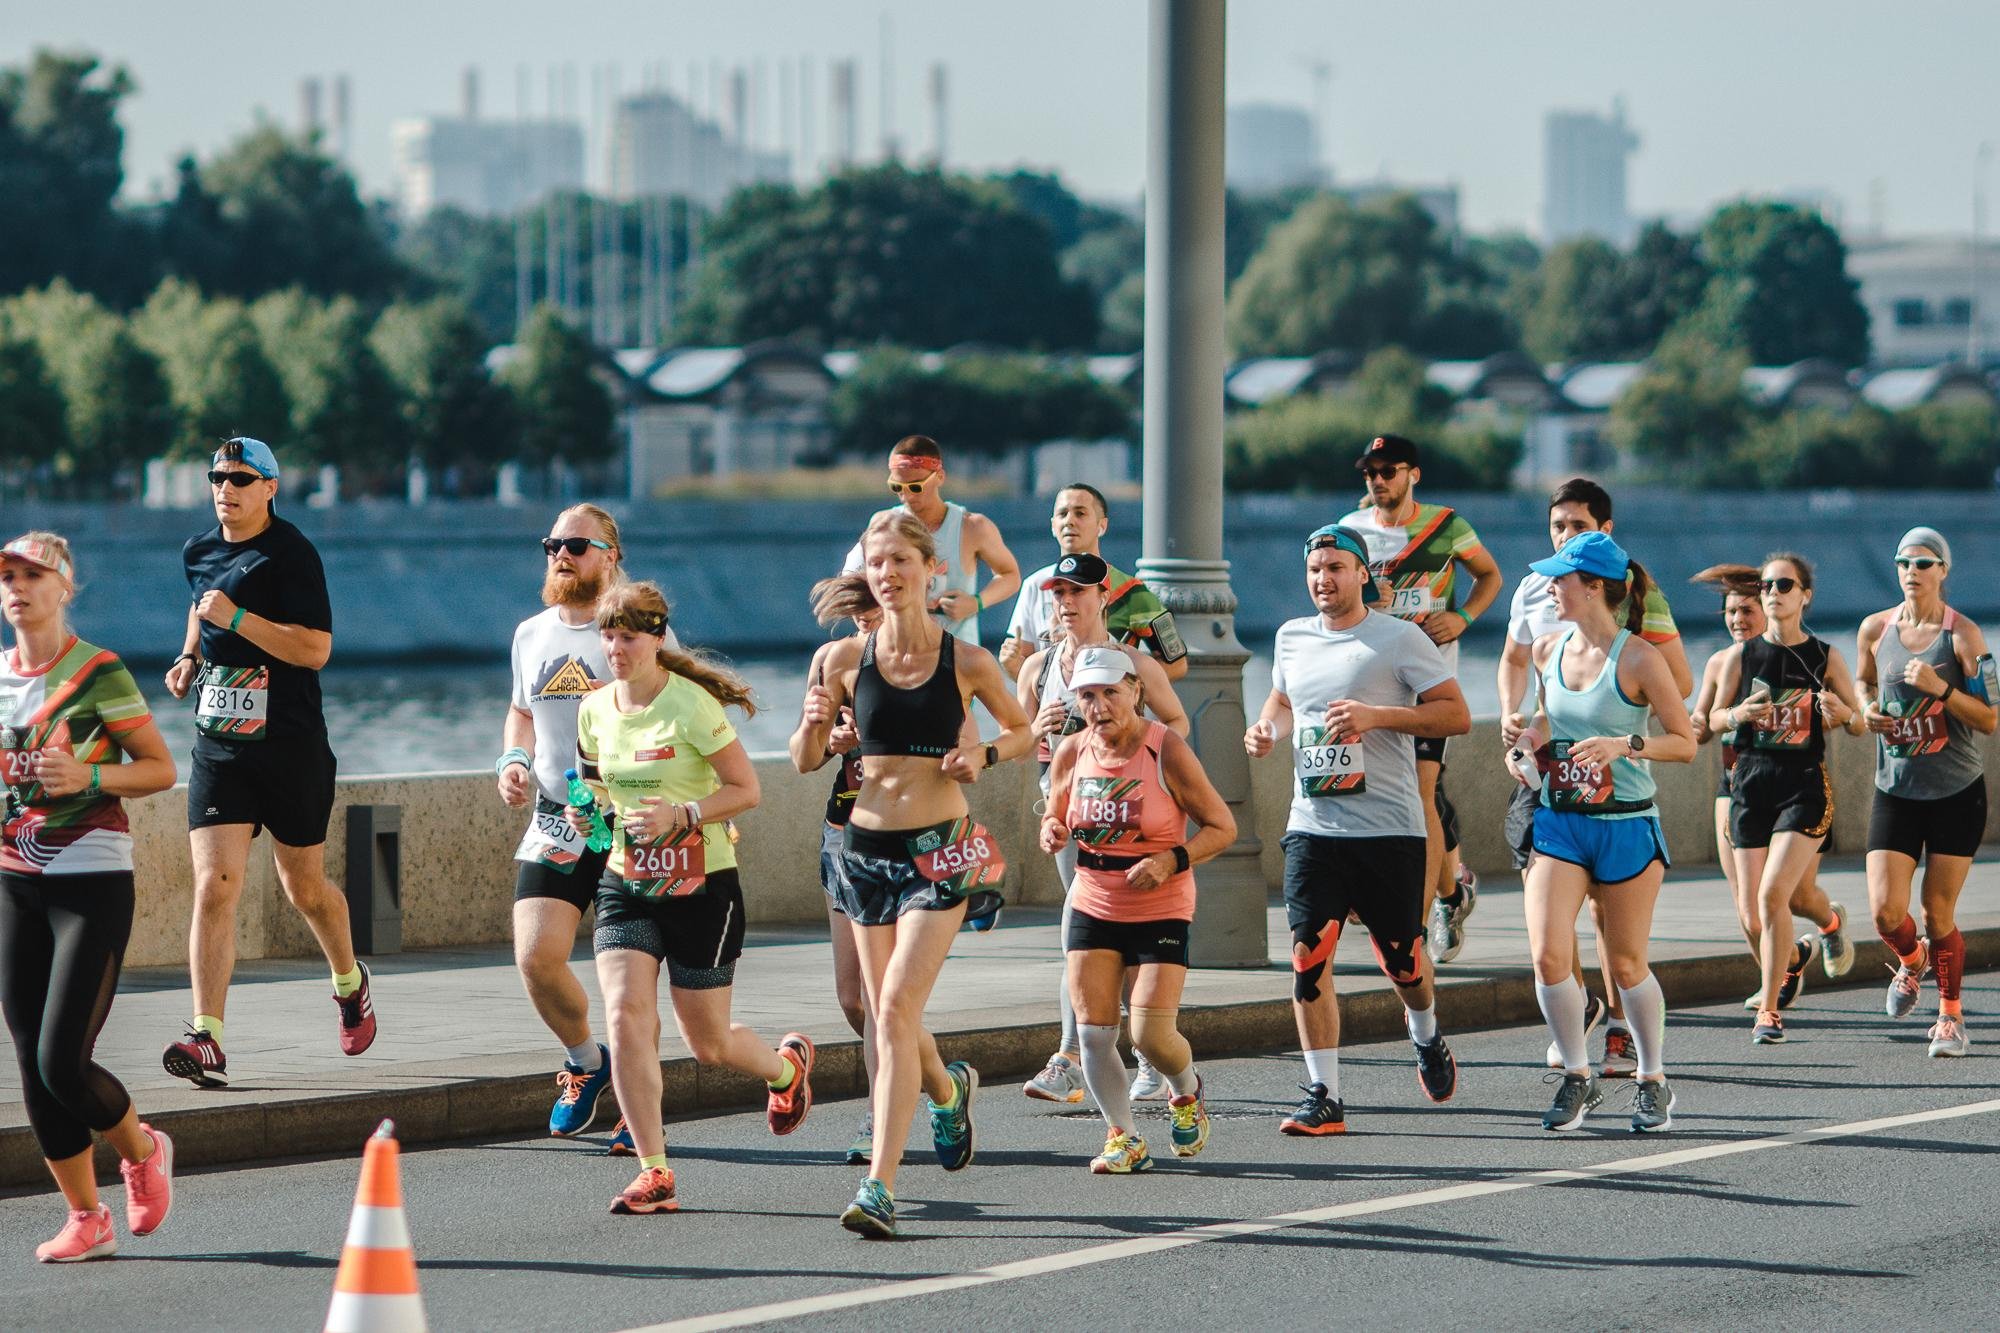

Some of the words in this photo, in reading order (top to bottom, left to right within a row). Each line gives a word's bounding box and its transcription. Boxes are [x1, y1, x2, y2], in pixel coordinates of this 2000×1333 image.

[1391, 590, 1421, 607] 775
[557, 682, 578, 691] HIGH
[562, 676, 578, 684] RUN
[208, 688, 254, 710] 2816
[1772, 706, 1801, 726] 121
[6, 751, 43, 776] 299
[1304, 747, 1351, 769] 3696
[1555, 790, 1563, 802] F
[1081, 799, 1128, 822] 1381
[634, 847, 688, 871] 2601
[933, 837, 991, 872] 4568
[632, 881, 640, 894] F
